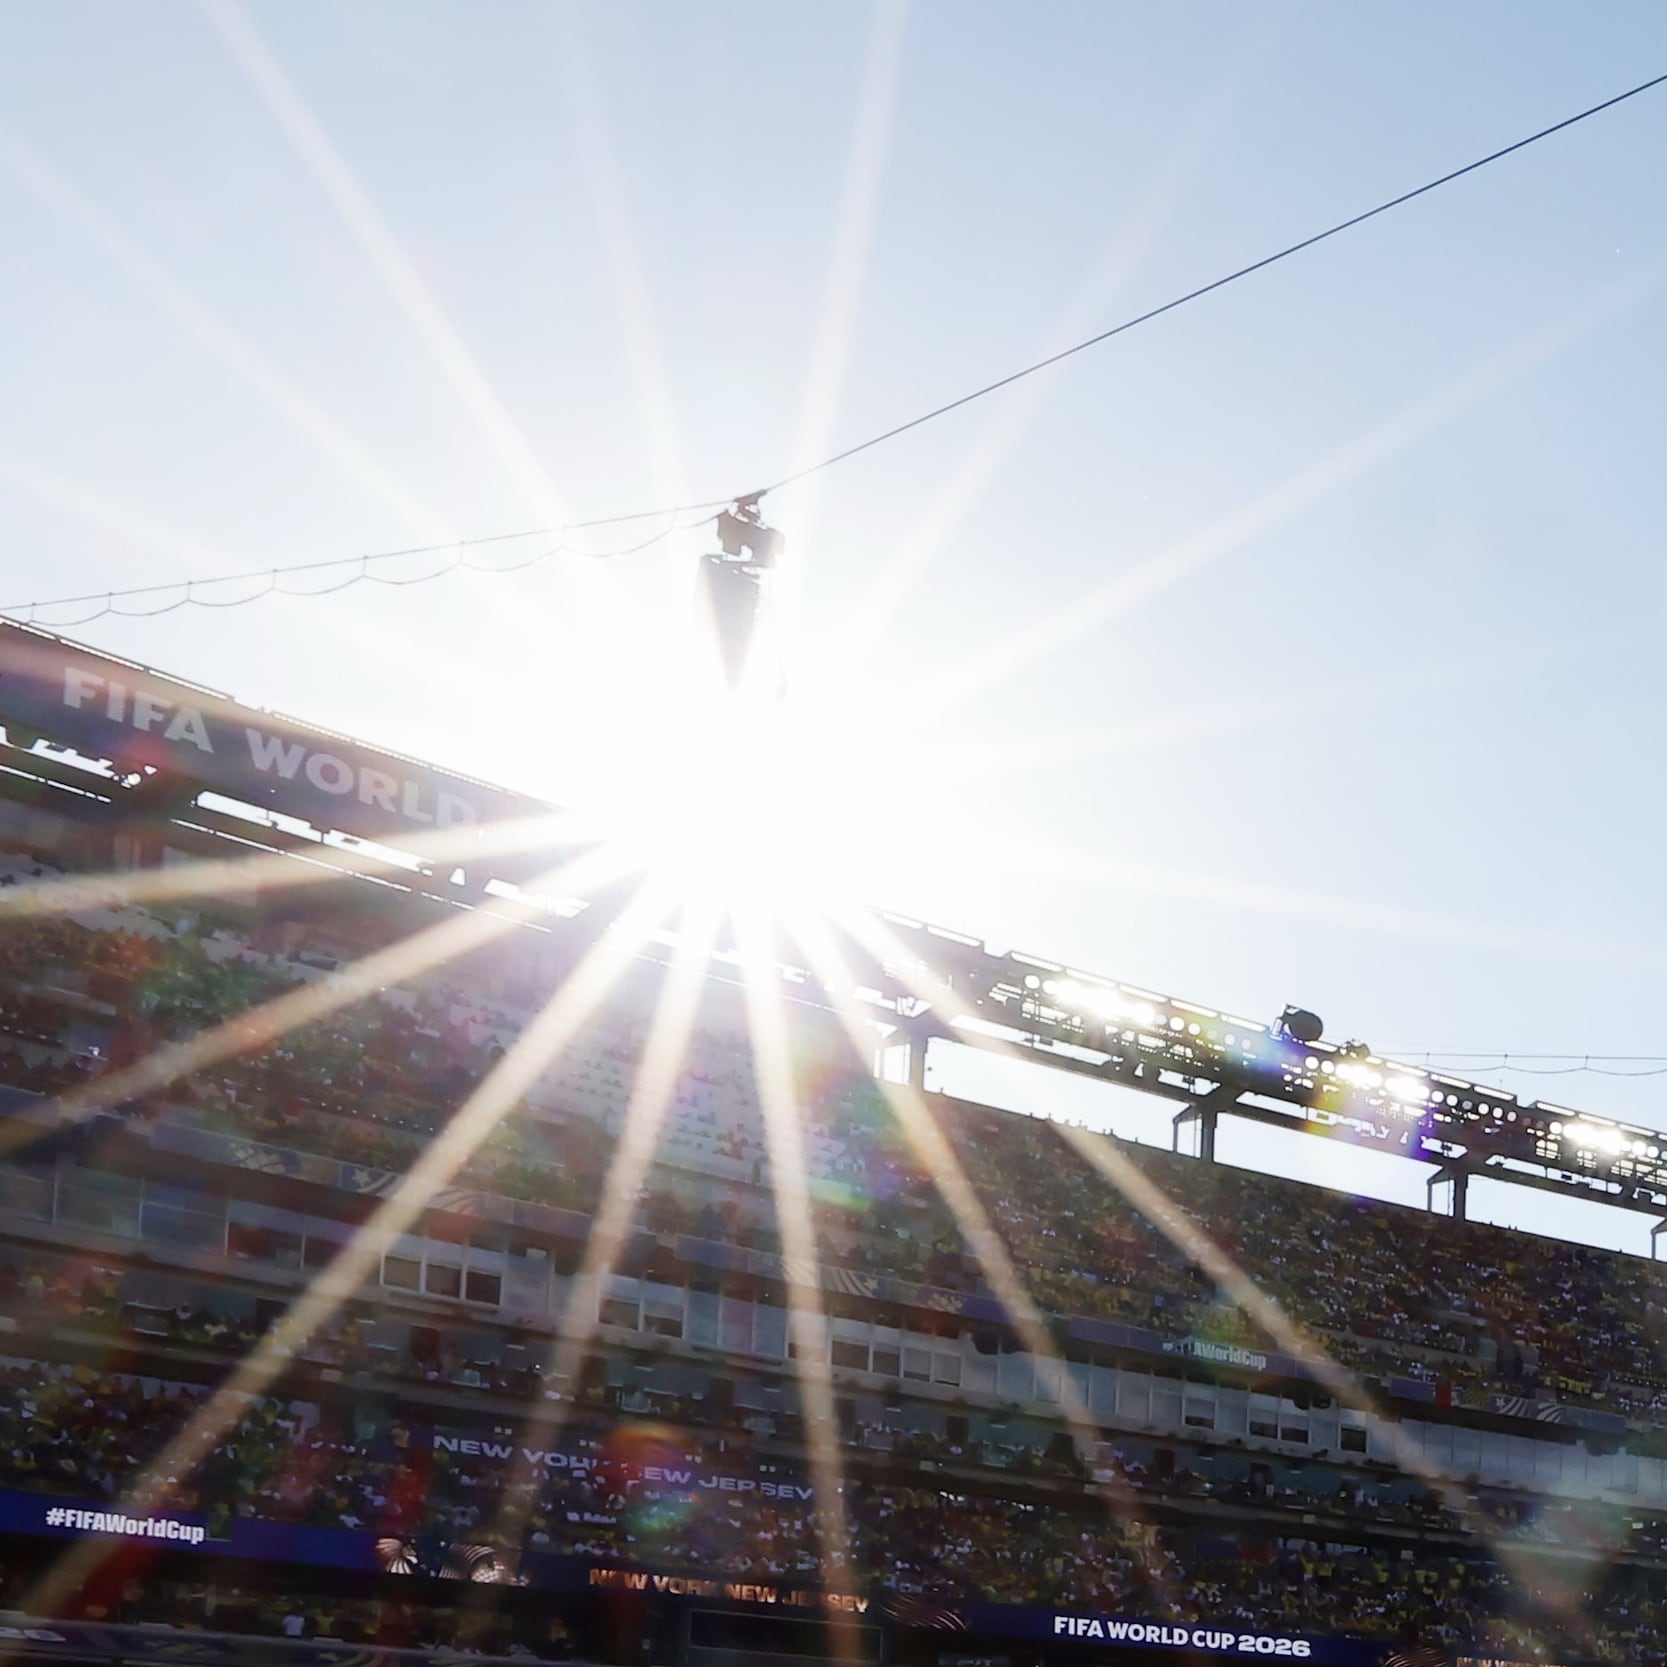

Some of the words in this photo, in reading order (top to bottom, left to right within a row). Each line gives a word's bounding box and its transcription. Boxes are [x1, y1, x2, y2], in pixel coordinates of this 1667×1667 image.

[63, 667, 215, 754] FIFA
[245, 727, 477, 828] WORLD
[1162, 1341, 1267, 1371] AWorldCup
[433, 1435, 513, 1459] NEW
[45, 1507, 205, 1545] #FIFAWorldCup
[589, 1567, 648, 1590] NW
[725, 1582, 778, 1604] NEW
[783, 1590, 870, 1614] JESEY
[1054, 1616, 1104, 1638] FIFA
[1107, 1620, 1189, 1646] WORLD
[1191, 1629, 1235, 1650] CUP
[1238, 1634, 1312, 1657] 2026
